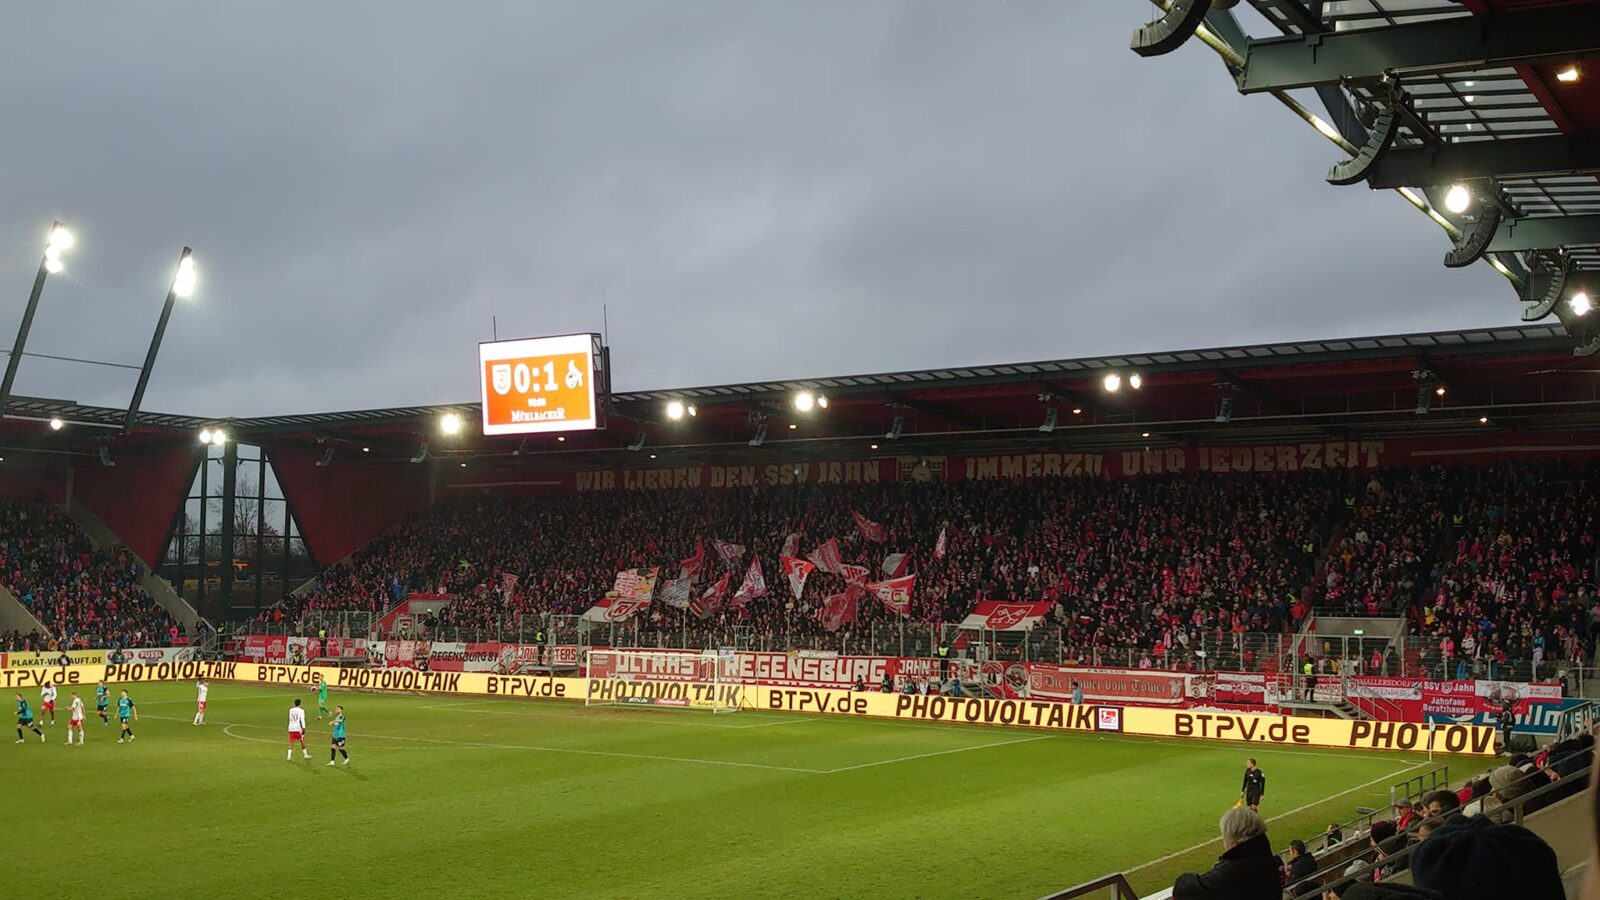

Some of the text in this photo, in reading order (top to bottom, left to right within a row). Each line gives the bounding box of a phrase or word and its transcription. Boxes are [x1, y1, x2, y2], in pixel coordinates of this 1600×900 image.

[514, 361, 558, 394] 0:1
[1121, 448, 1186, 475] UND
[576, 469, 616, 491] WIR
[710, 465, 756, 488] DEN
[766, 462, 810, 486] SSV
[817, 460, 880, 484] JAHN
[11, 656, 102, 667] PLAKAT-VEAUFT.DE
[431, 651, 486, 662] REGENSBURG
[616, 651, 694, 674] ULTRAS
[725, 655, 886, 683] REGENSBURG
[898, 659, 930, 675] JAHN
[104, 660, 237, 681] PHOTOVOLTAIK
[258, 665, 323, 684] BTPV.de
[338, 668, 460, 692] PHOTOVOLTAIK
[487, 677, 566, 697] BTPV.de
[588, 679, 740, 707] PHOTOVOLTAIK
[1044, 674, 1063, 689] Die
[1105, 680, 1127, 691] vom
[1424, 681, 1475, 692] SSV Jahn
[769, 689, 868, 714] BTPV.de
[896, 694, 1094, 730] PHOTOVOLTAIK
[1422, 703, 1474, 714] Beratzhausen
[1430, 696, 1466, 706] Jahnfans
[1175, 713, 1310, 744] BTPV.de
[1350, 720, 1495, 754] PHOTOV
